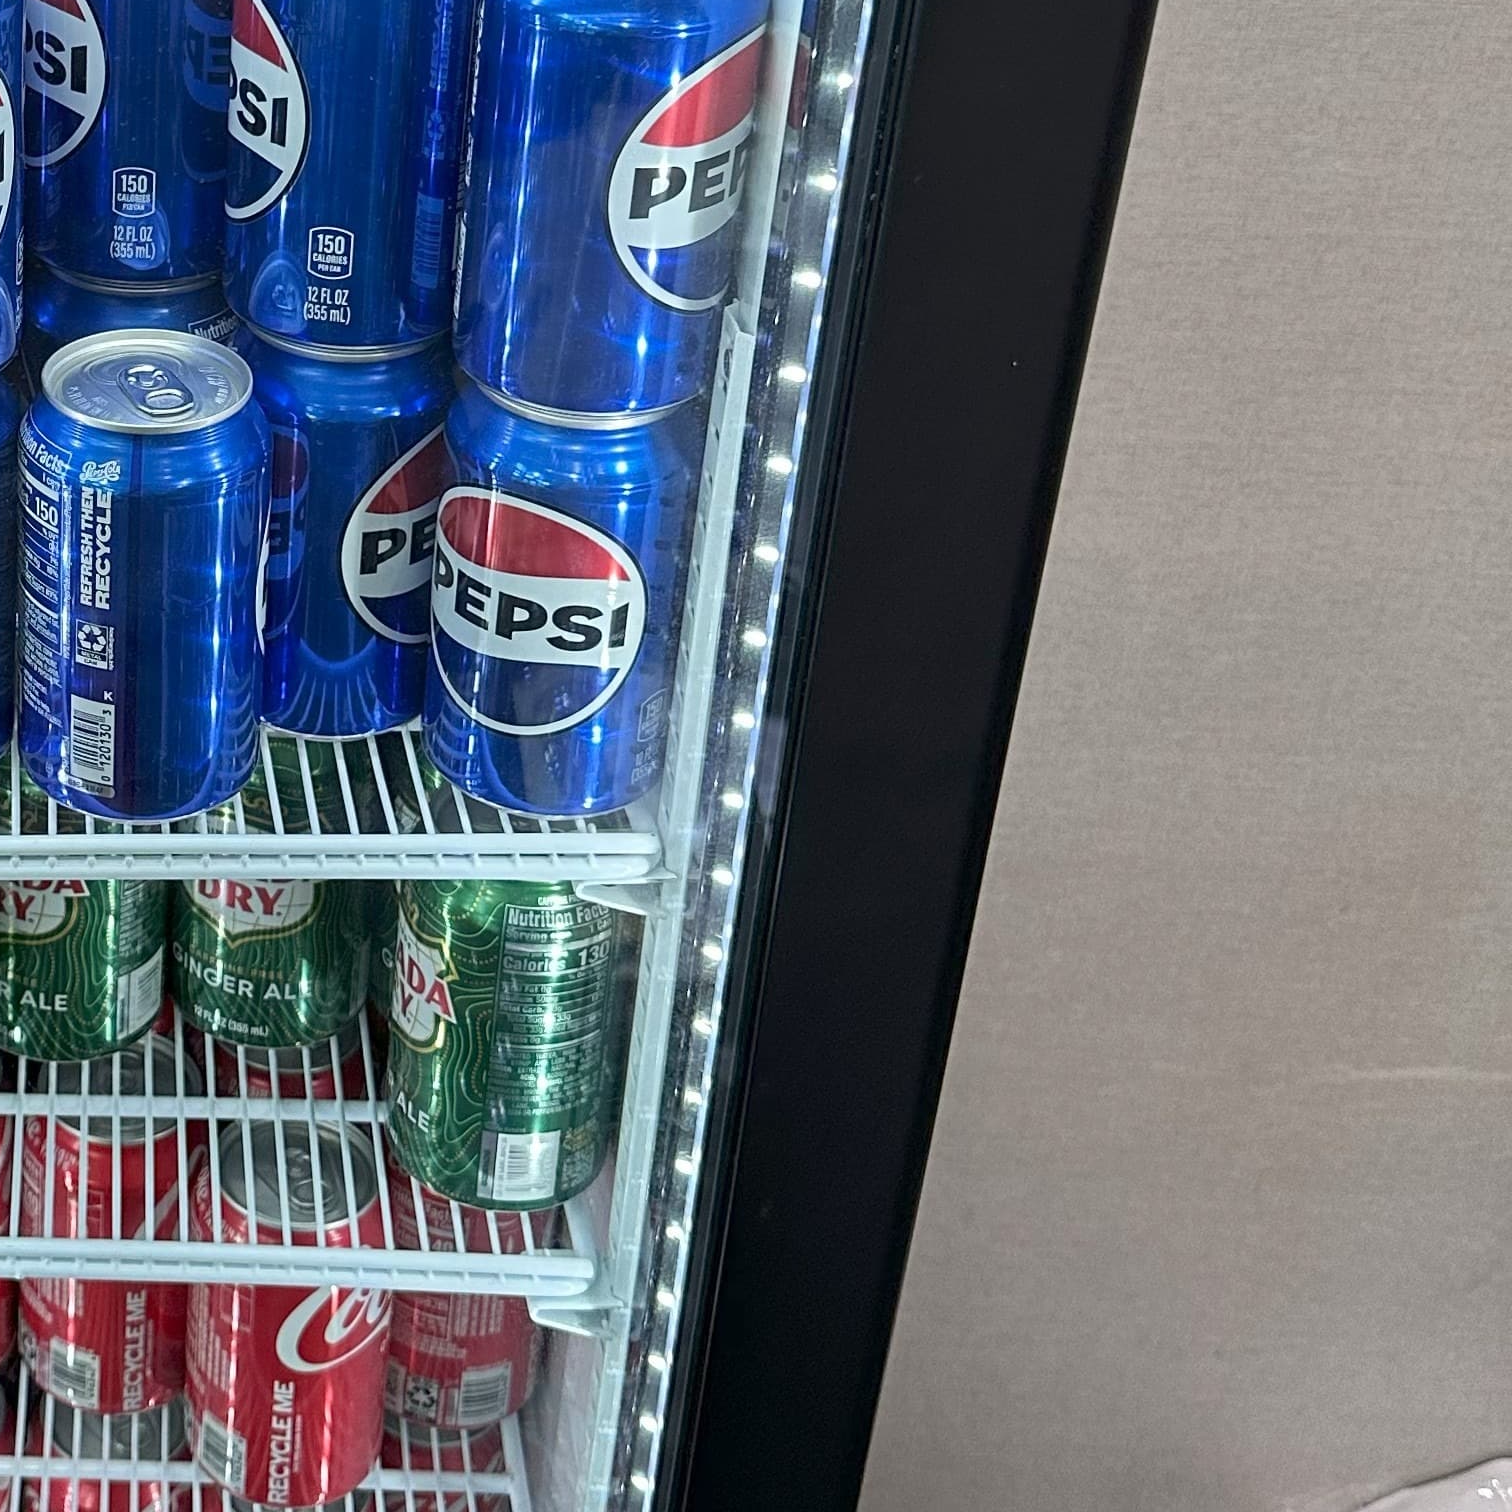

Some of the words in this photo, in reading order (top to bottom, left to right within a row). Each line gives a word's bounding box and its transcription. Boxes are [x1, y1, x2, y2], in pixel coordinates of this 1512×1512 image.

[229, 63, 289, 148] SI
[117, 193, 150, 203] CALORIES
[120, 174, 148, 193] 150
[113, 225, 125, 240] 12
[126, 226, 138, 241] FL
[139, 226, 153, 242] OZ
[317, 234, 345, 255] 150
[110, 243, 133, 259] (355
[136, 243, 155, 260] mL)
[312, 253, 348, 265] CALORIES
[307, 286, 318, 302] 12
[321, 288, 332, 304] FL
[335, 289, 349, 306] OZ
[304, 302, 327, 321] (355
[329, 307, 351, 325] mL)
[35, 444, 65, 474] Facts
[35, 497, 58, 527] 150
[81, 486, 94, 529] THEN
[96, 489, 112, 610] RECYCLE
[80, 532, 94, 606] REFRESH
[434, 541, 630, 652] PEPSI
[104, 691, 113, 701] K
[99, 724, 112, 766] 120130
[508, 908, 573, 928] Nutrition
[576, 904, 609, 923] Facts
[172, 942, 254, 999] GINGER
[503, 955, 566, 972] Calories
[578, 940, 610, 966] 130
[20, 990, 68, 1011] ALE
[396, 1092, 429, 1133] ALE
[127, 1289, 147, 1320] ME
[123, 1322, 145, 1411] RECYCLE
[273, 1380, 294, 1414] ME
[267, 1416, 293, 1504] RECYCLE
